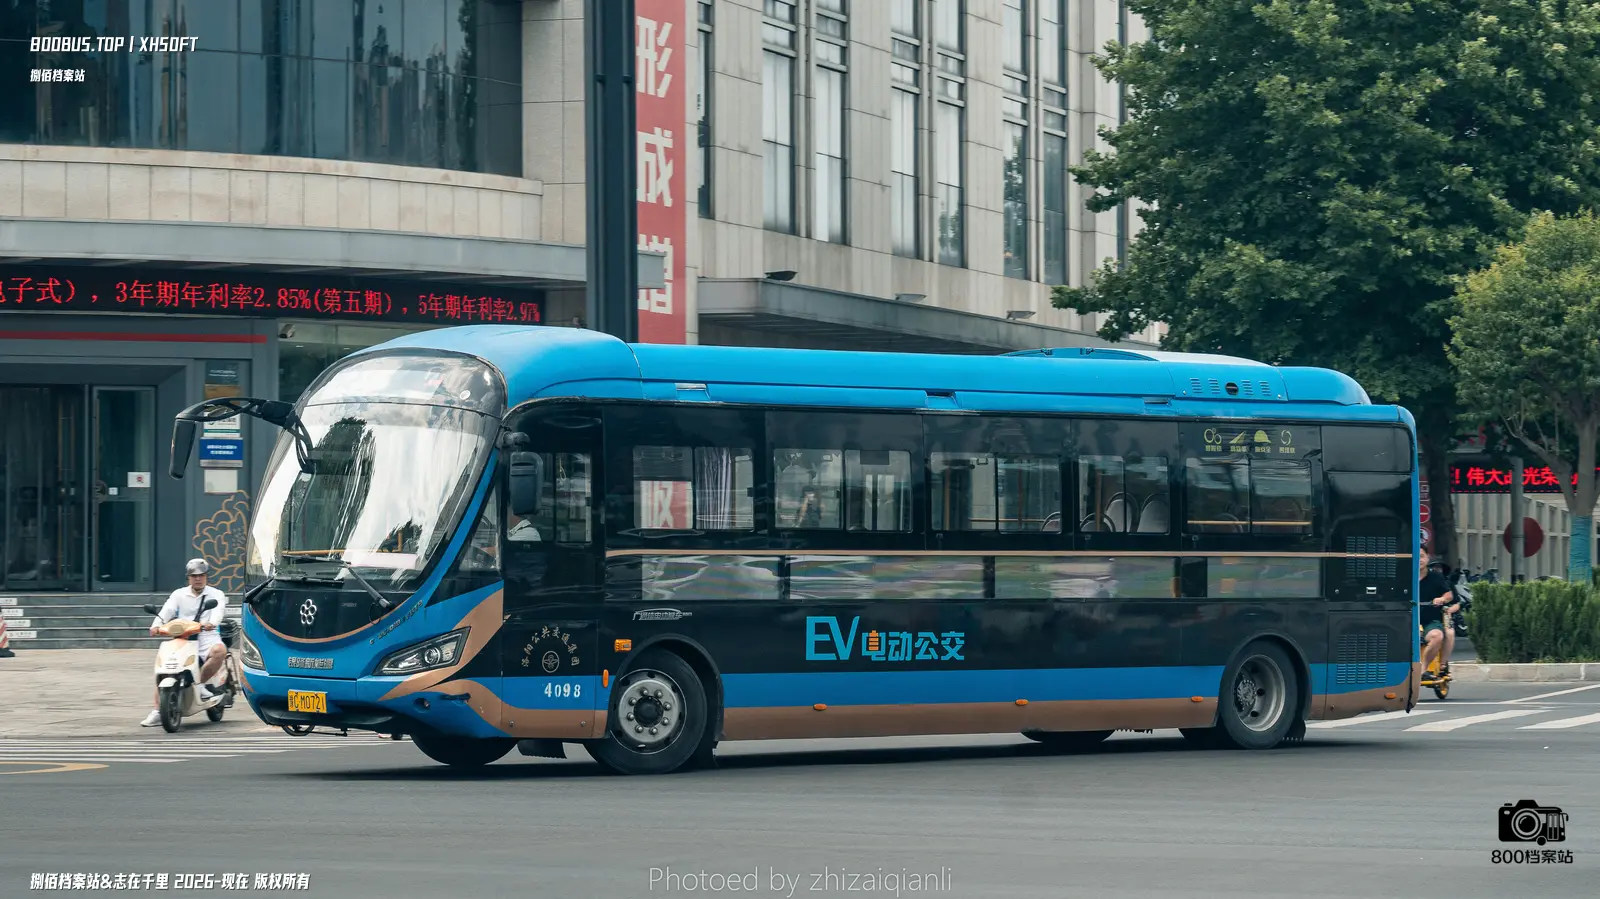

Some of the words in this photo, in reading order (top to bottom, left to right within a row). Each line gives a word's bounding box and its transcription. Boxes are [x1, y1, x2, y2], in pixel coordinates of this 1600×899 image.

[806, 616, 860, 661] EV
[861, 630, 965, 662] 电动公交
[544, 682, 581, 698] 4098
